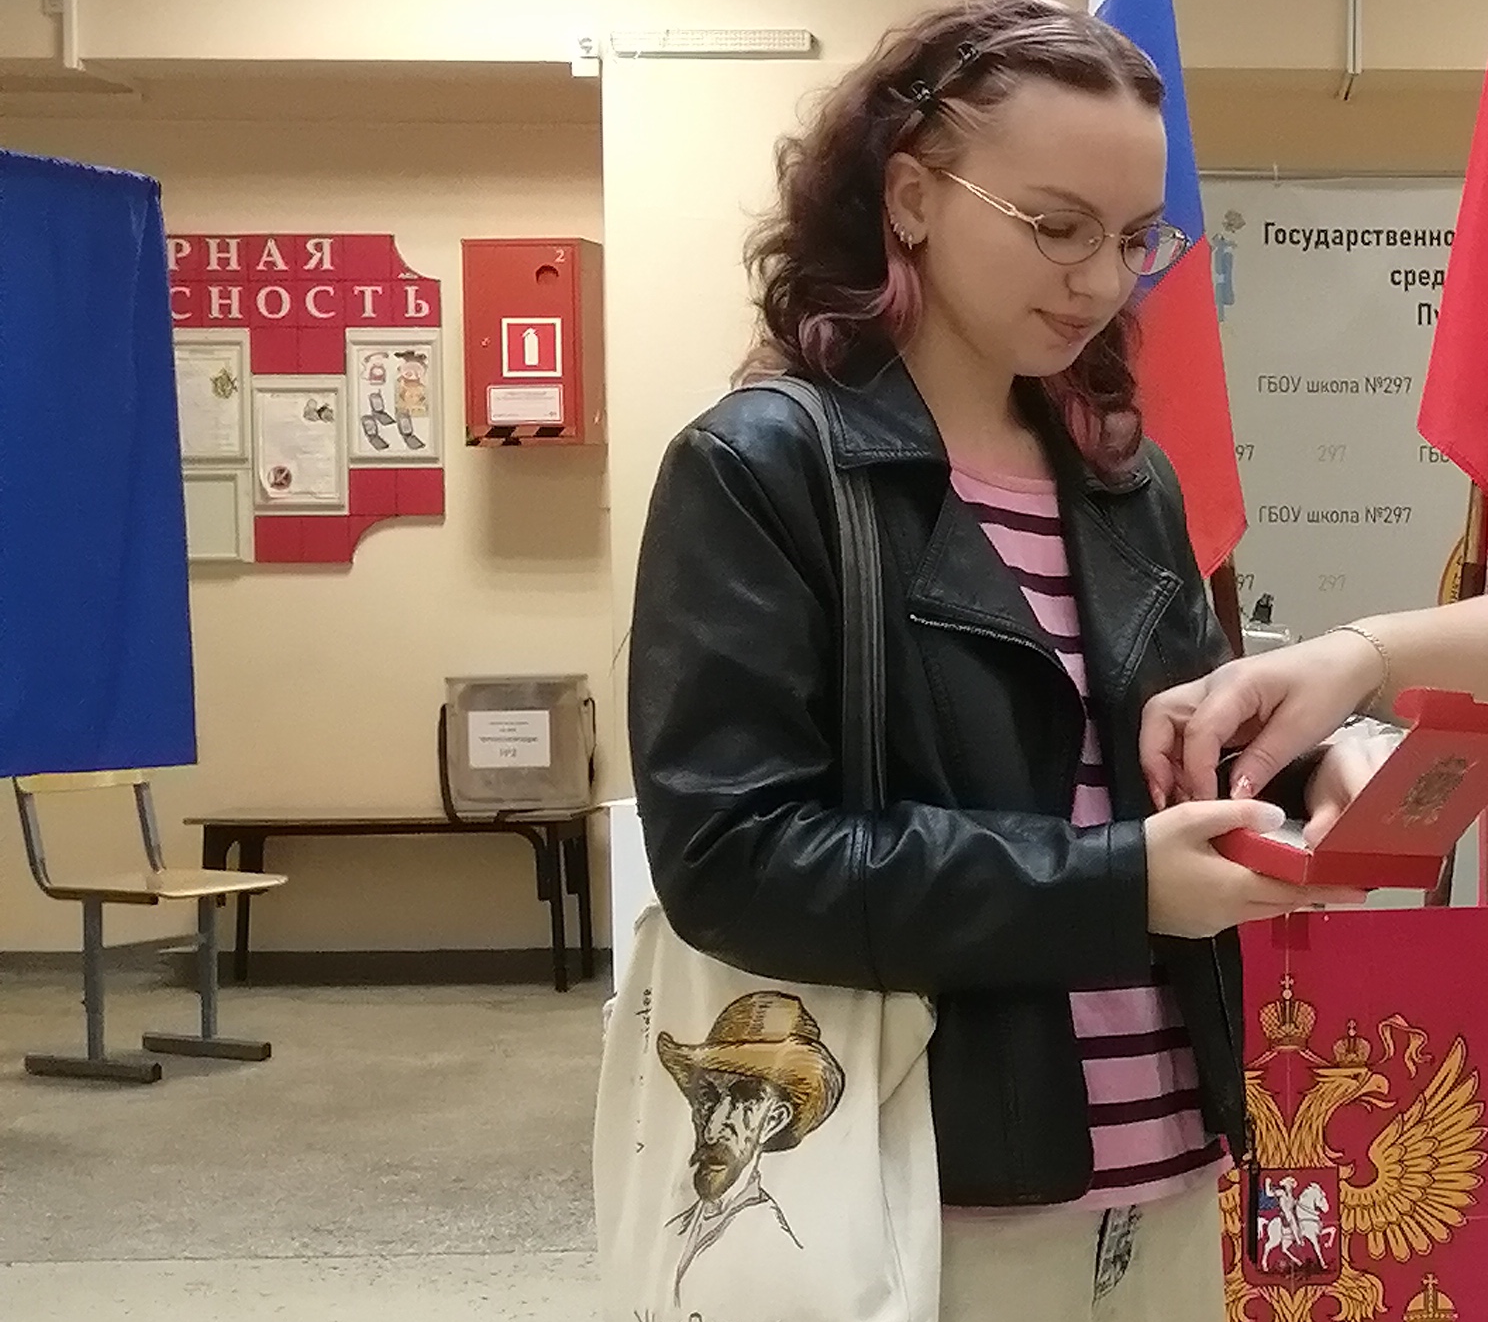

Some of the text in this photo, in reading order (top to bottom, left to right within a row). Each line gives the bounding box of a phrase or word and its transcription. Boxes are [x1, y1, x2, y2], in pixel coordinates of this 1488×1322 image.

[1264, 222, 1455, 252] Государственно
[167, 238, 334, 272] РНАЯ
[169, 285, 430, 320] СНОСТЬ
[1258, 375, 1412, 394] ГБОУ школа №297
[1317, 444, 1347, 462] 297
[1258, 505, 1412, 524] ГБОУ школа №297
[1317, 574, 1346, 592] 297
